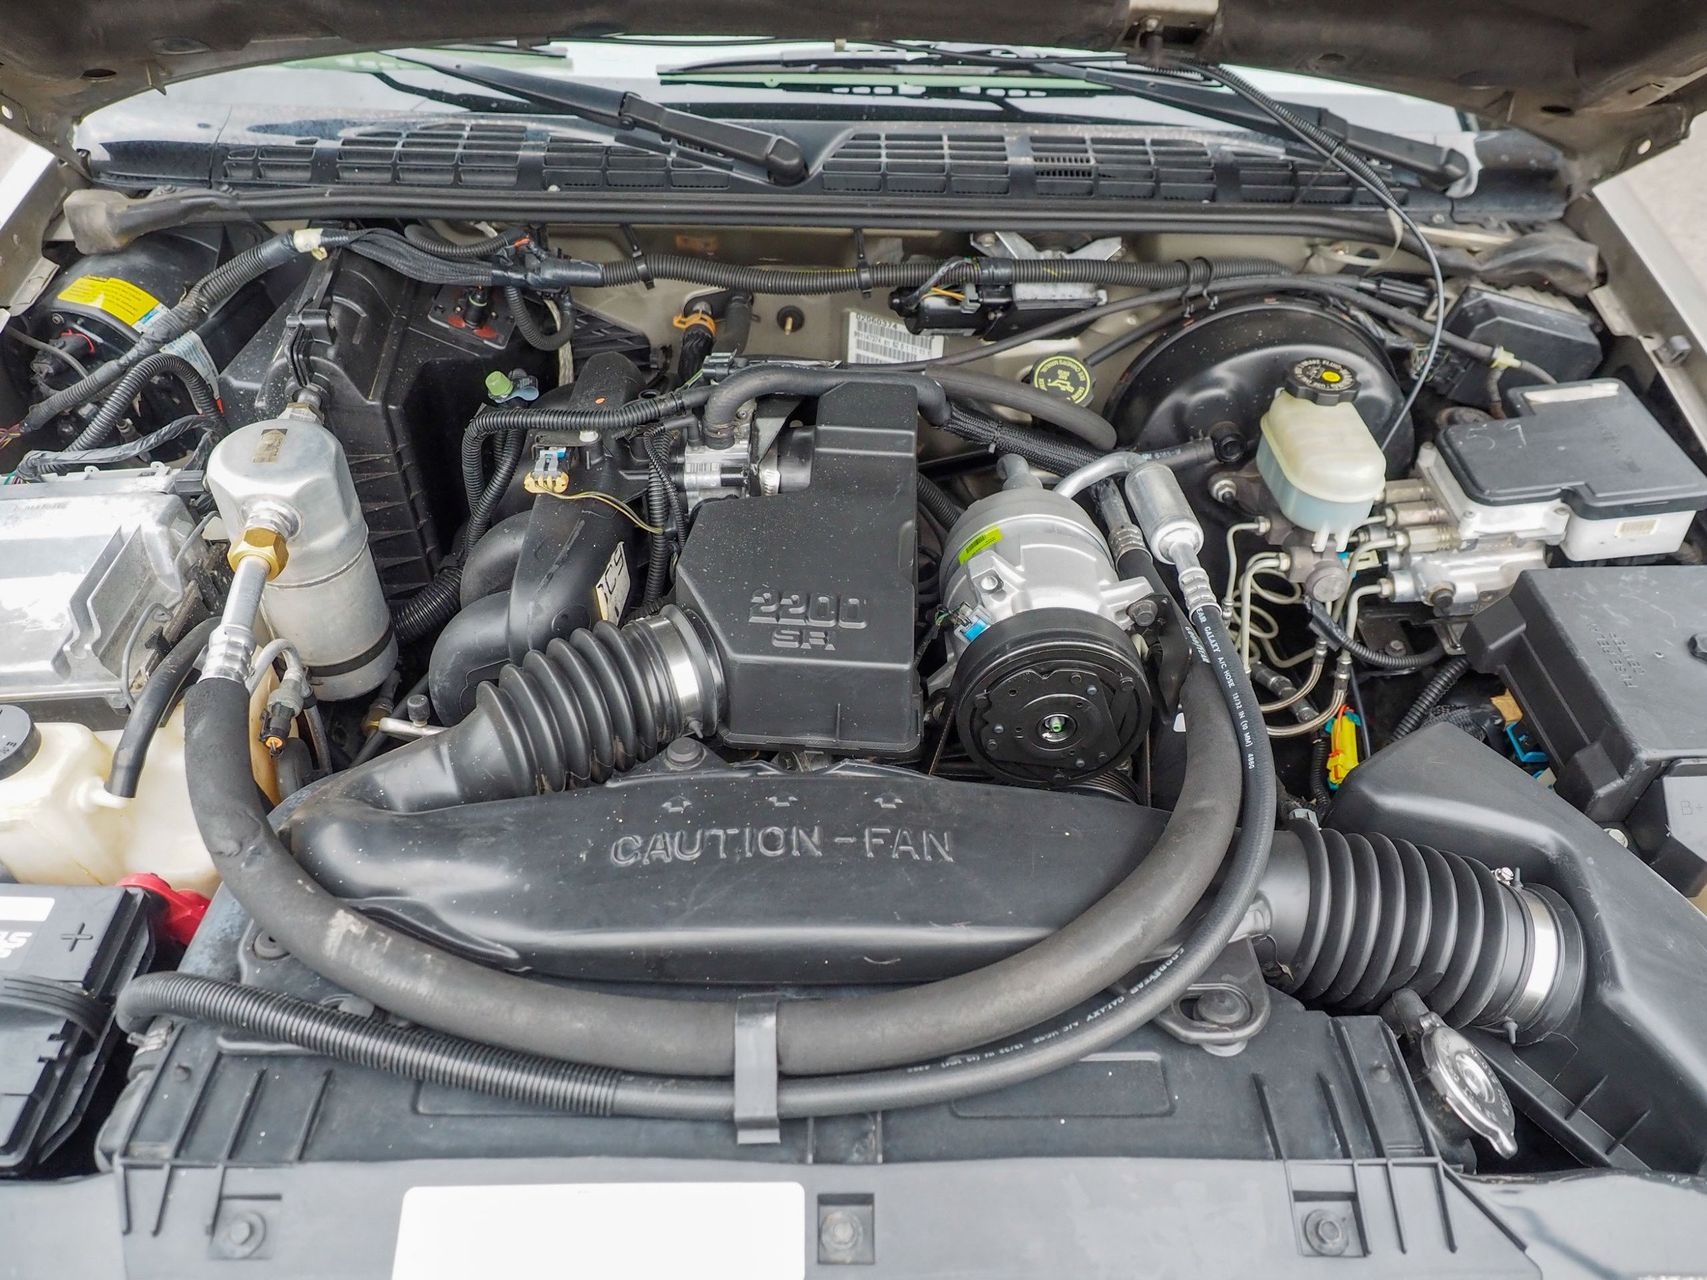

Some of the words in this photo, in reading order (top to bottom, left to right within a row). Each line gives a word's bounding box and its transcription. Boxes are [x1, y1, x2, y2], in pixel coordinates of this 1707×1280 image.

[749, 590, 867, 629] 2200
[772, 629, 836, 651] SR
[1204, 626, 1221, 653] GALAXY
[1218, 656, 1227, 669] A/C
[1224, 669, 1236, 689] HOSE
[610, 825, 823, 868] CAUTION
[864, 826, 954, 863] FAN
